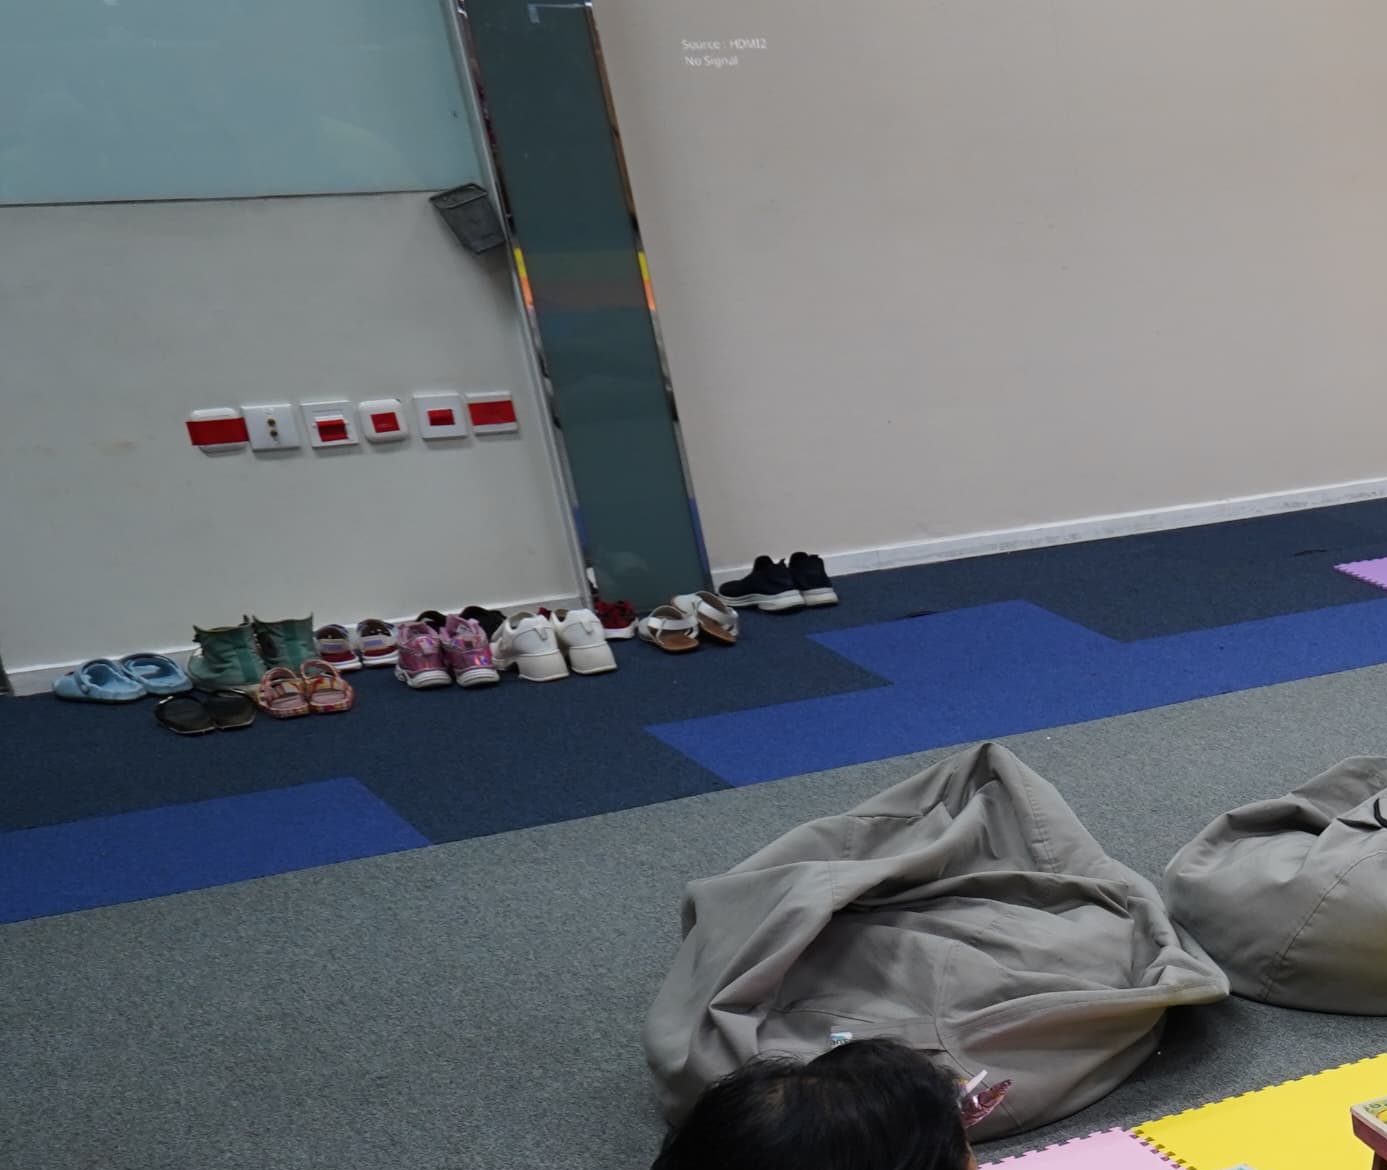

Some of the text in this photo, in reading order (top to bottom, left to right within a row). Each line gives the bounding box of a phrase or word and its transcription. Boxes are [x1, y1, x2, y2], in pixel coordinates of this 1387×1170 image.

[681, 39, 721, 50] Source
[685, 55, 739, 69] No Signal
